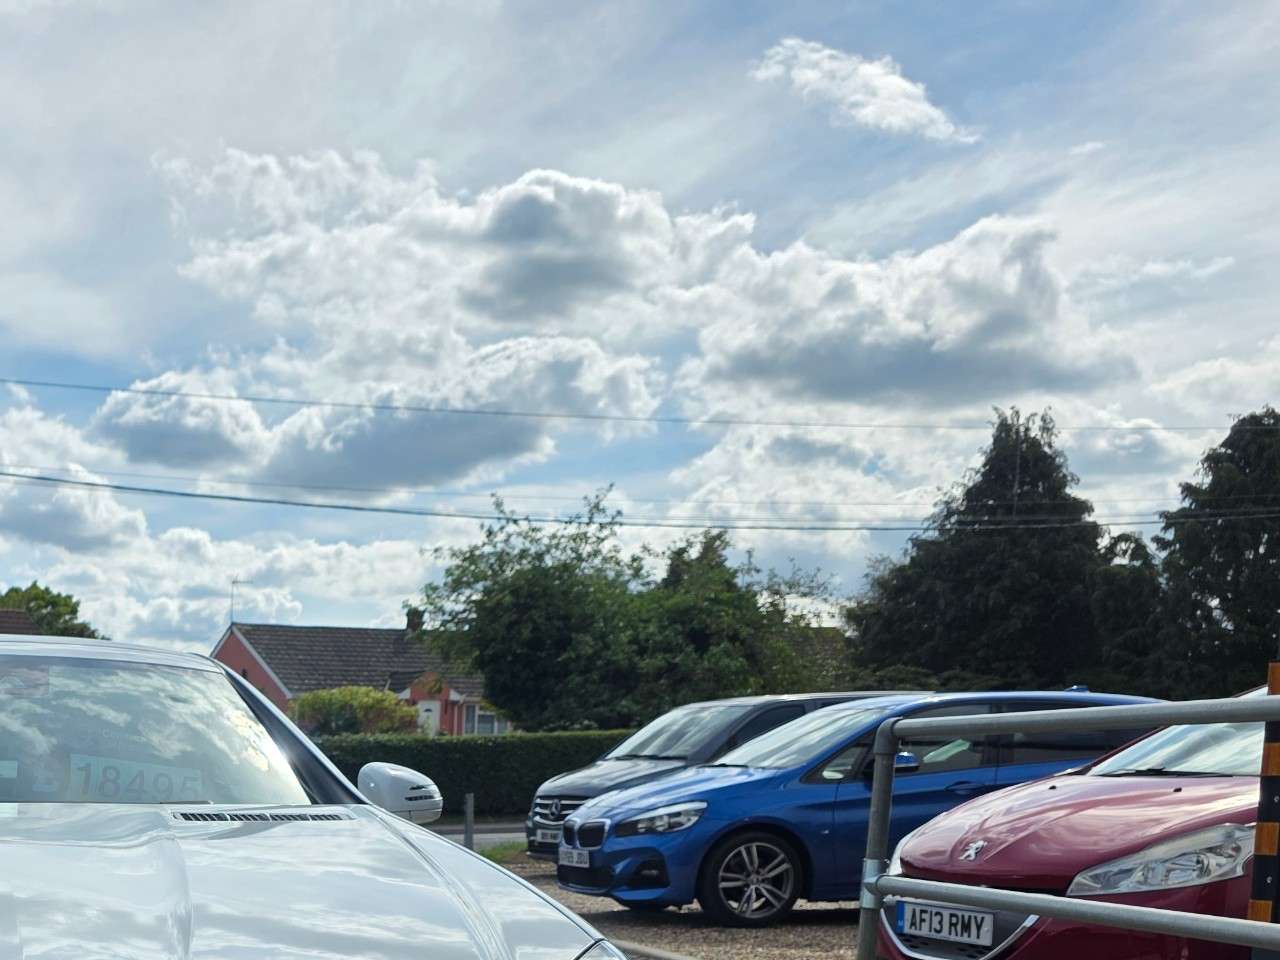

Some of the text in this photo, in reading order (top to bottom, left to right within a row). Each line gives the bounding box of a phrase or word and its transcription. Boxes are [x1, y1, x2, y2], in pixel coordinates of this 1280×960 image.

[76, 762, 199, 800] 18495
[909, 908, 985, 939] AF13 RMY
